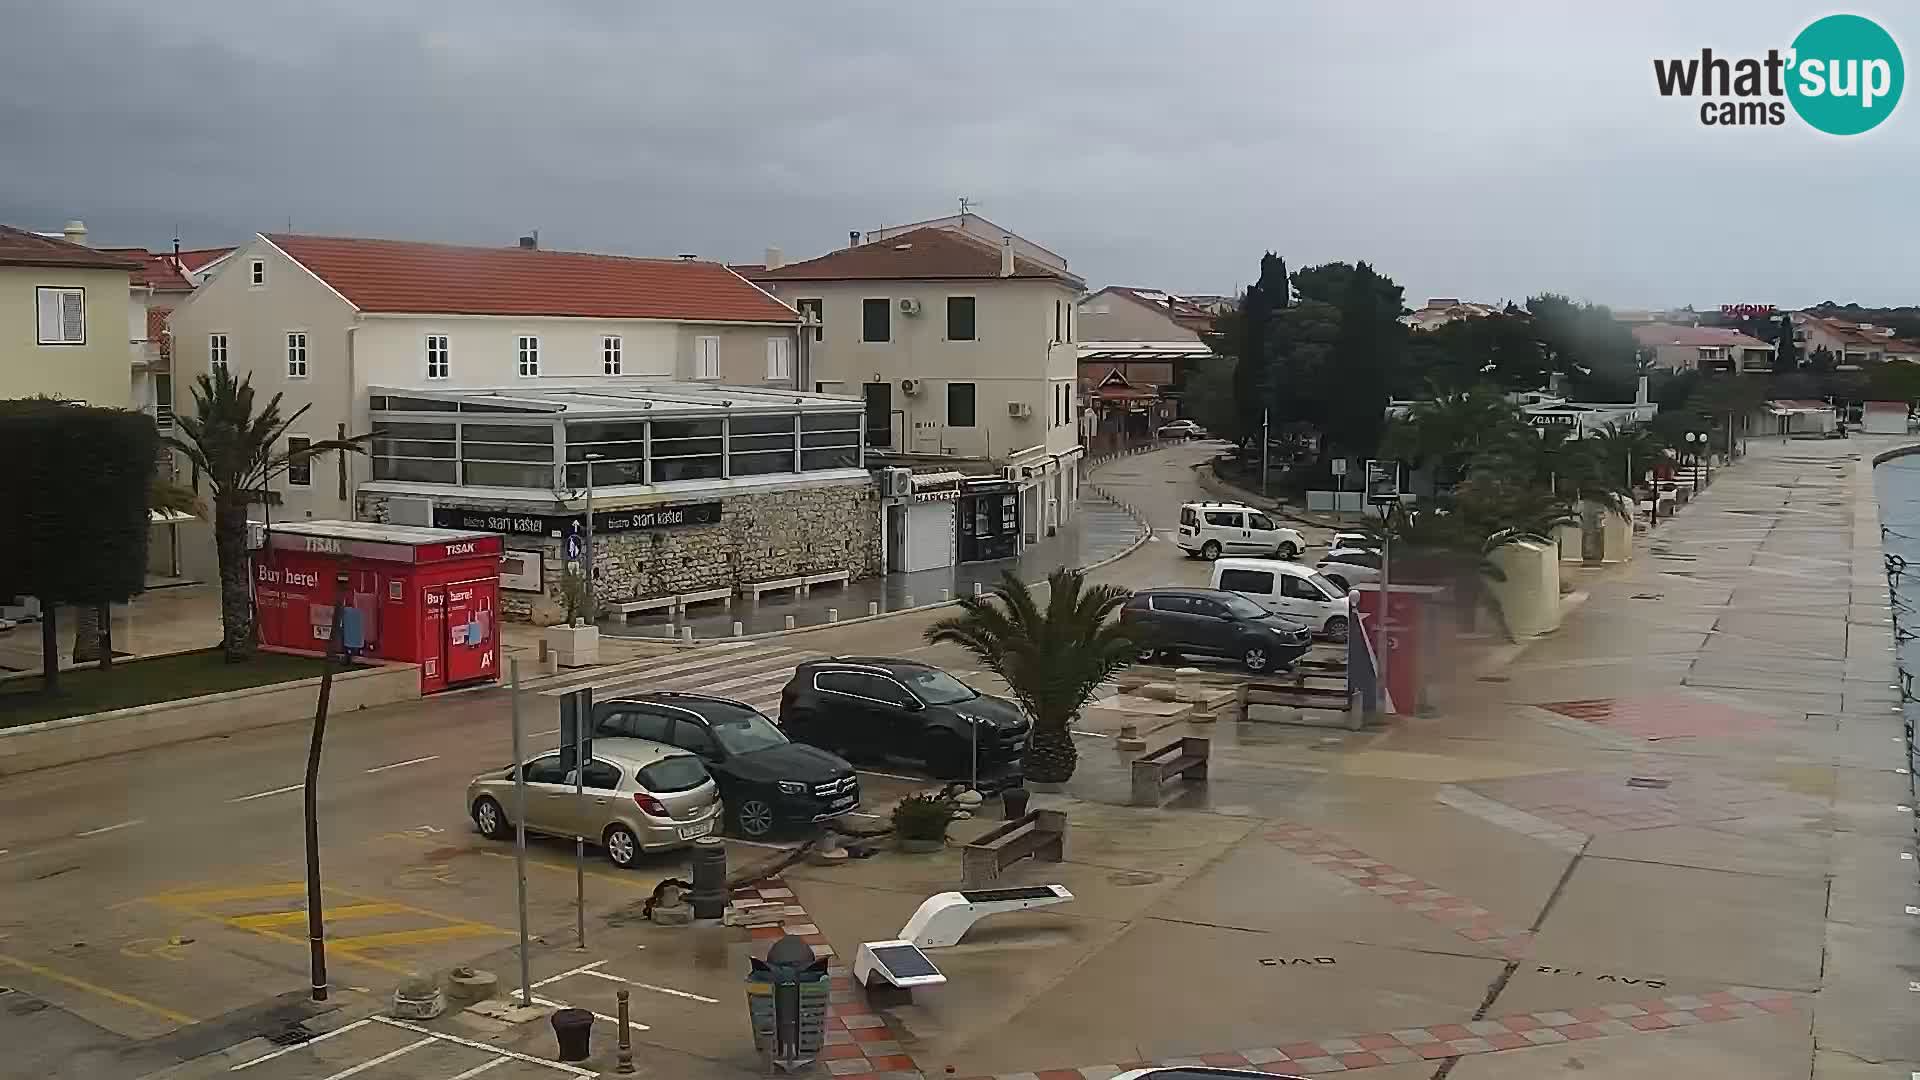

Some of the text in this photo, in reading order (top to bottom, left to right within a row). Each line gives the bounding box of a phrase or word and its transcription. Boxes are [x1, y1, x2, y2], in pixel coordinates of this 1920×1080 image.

[445, 543, 475, 556] TISAK
[258, 565, 319, 588] Buy here!
